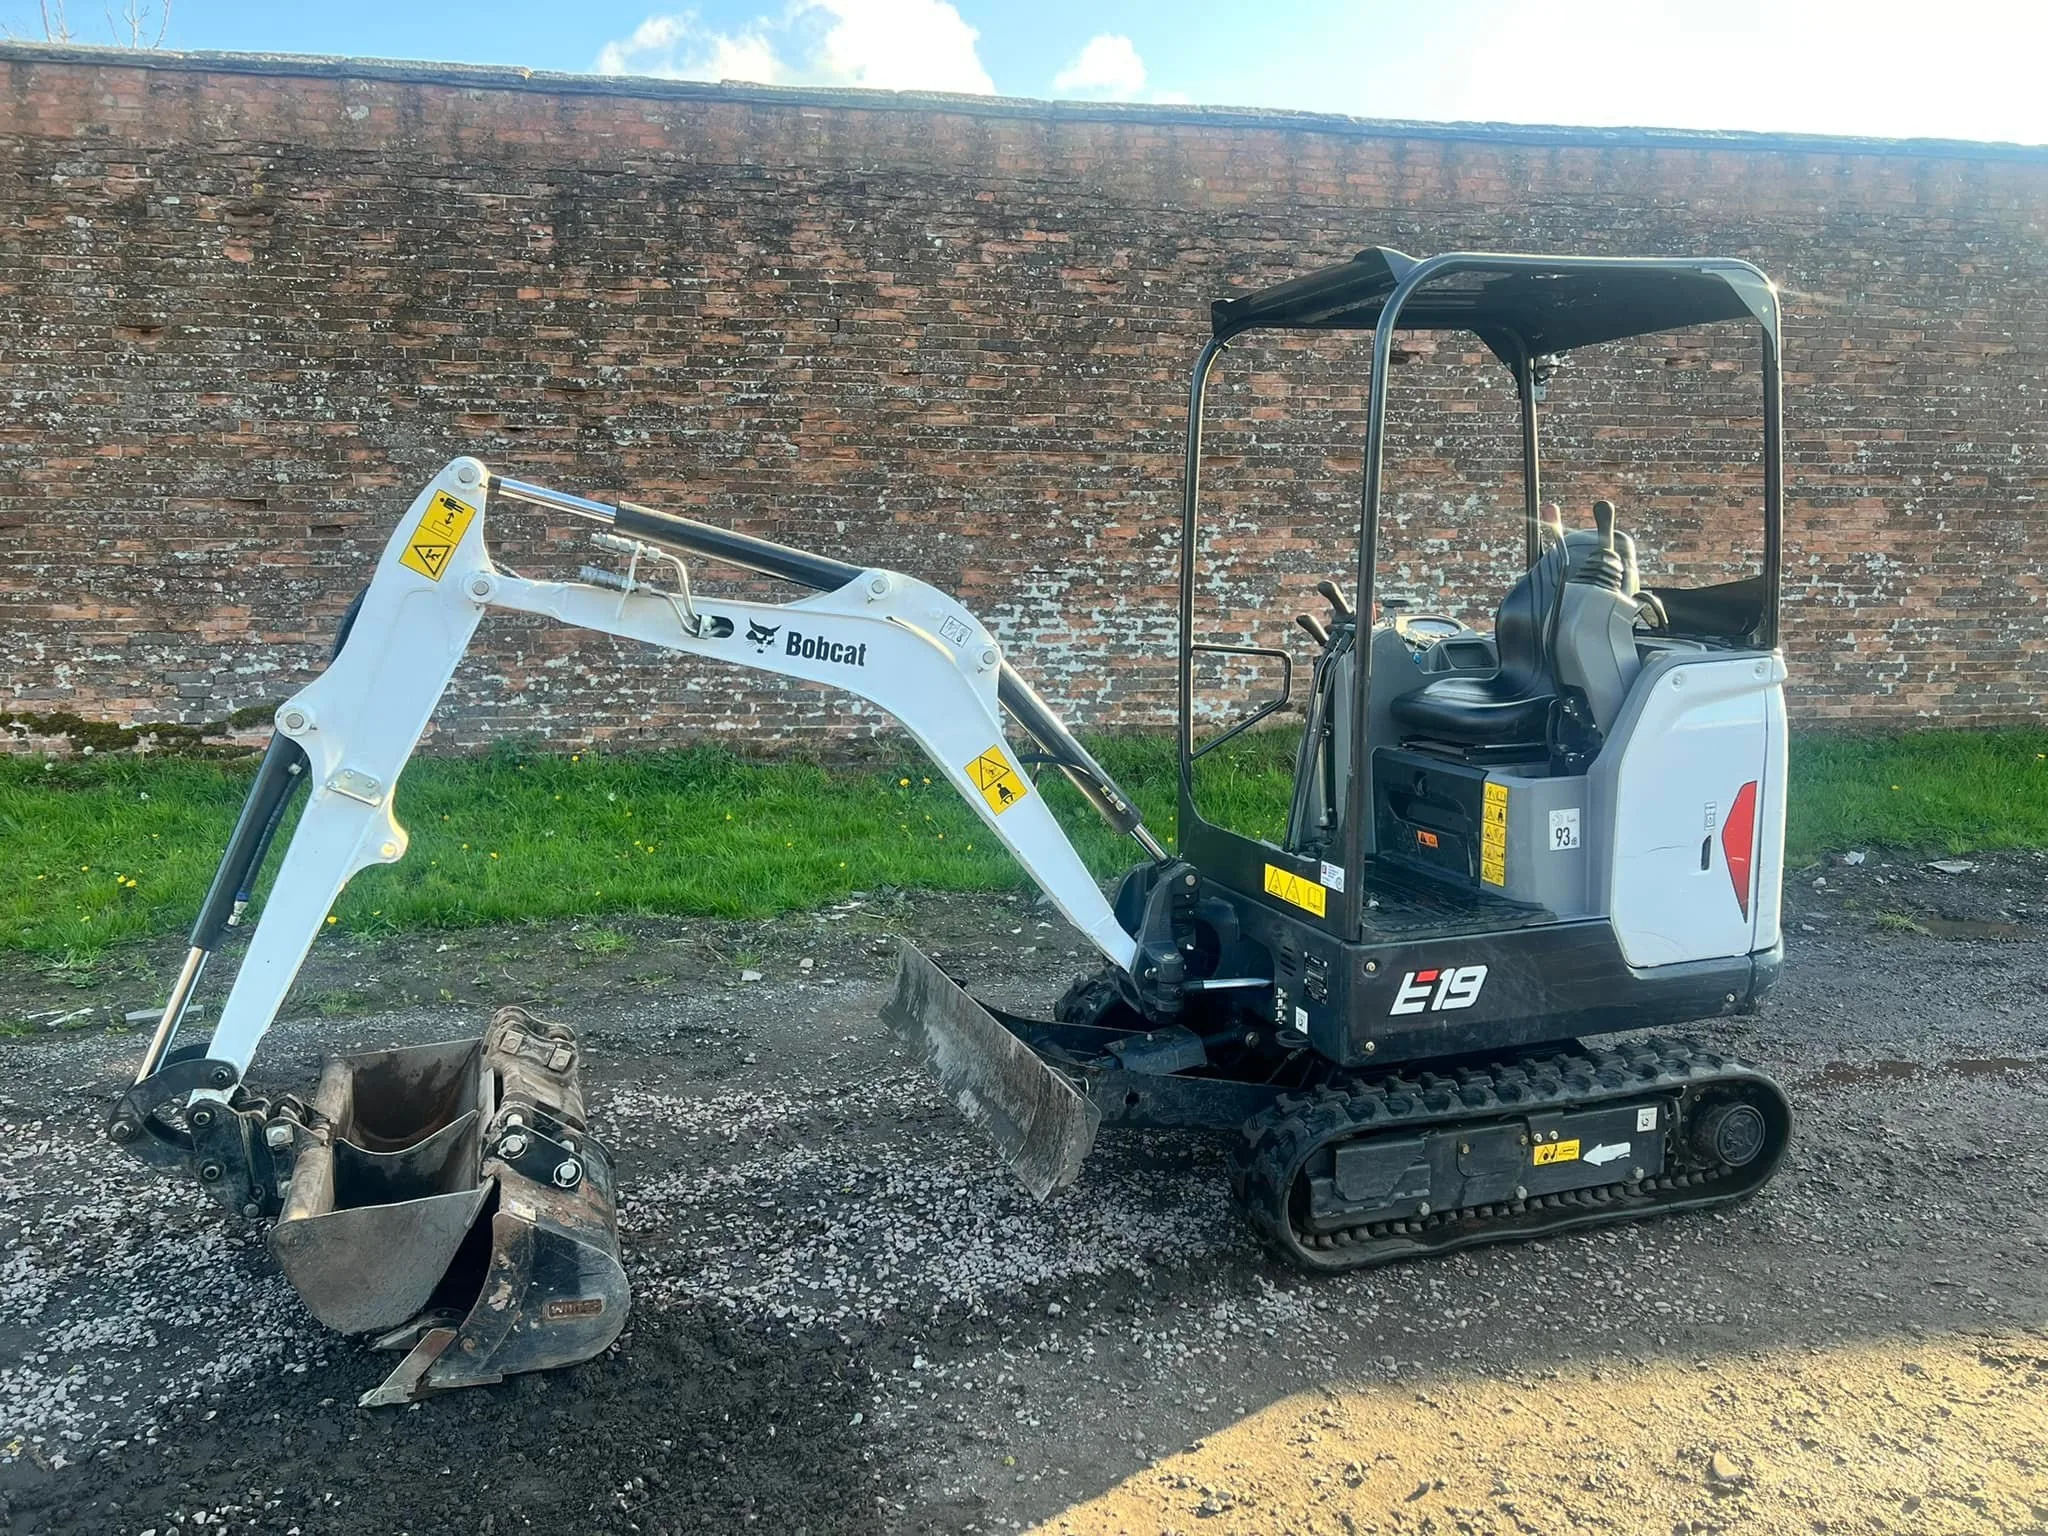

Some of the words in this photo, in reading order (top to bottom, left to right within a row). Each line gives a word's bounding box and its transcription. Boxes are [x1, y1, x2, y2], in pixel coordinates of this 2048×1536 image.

[785, 631, 867, 666] Bobcat
[1556, 827, 1570, 847] 93
[1390, 965, 1488, 1015] E19
